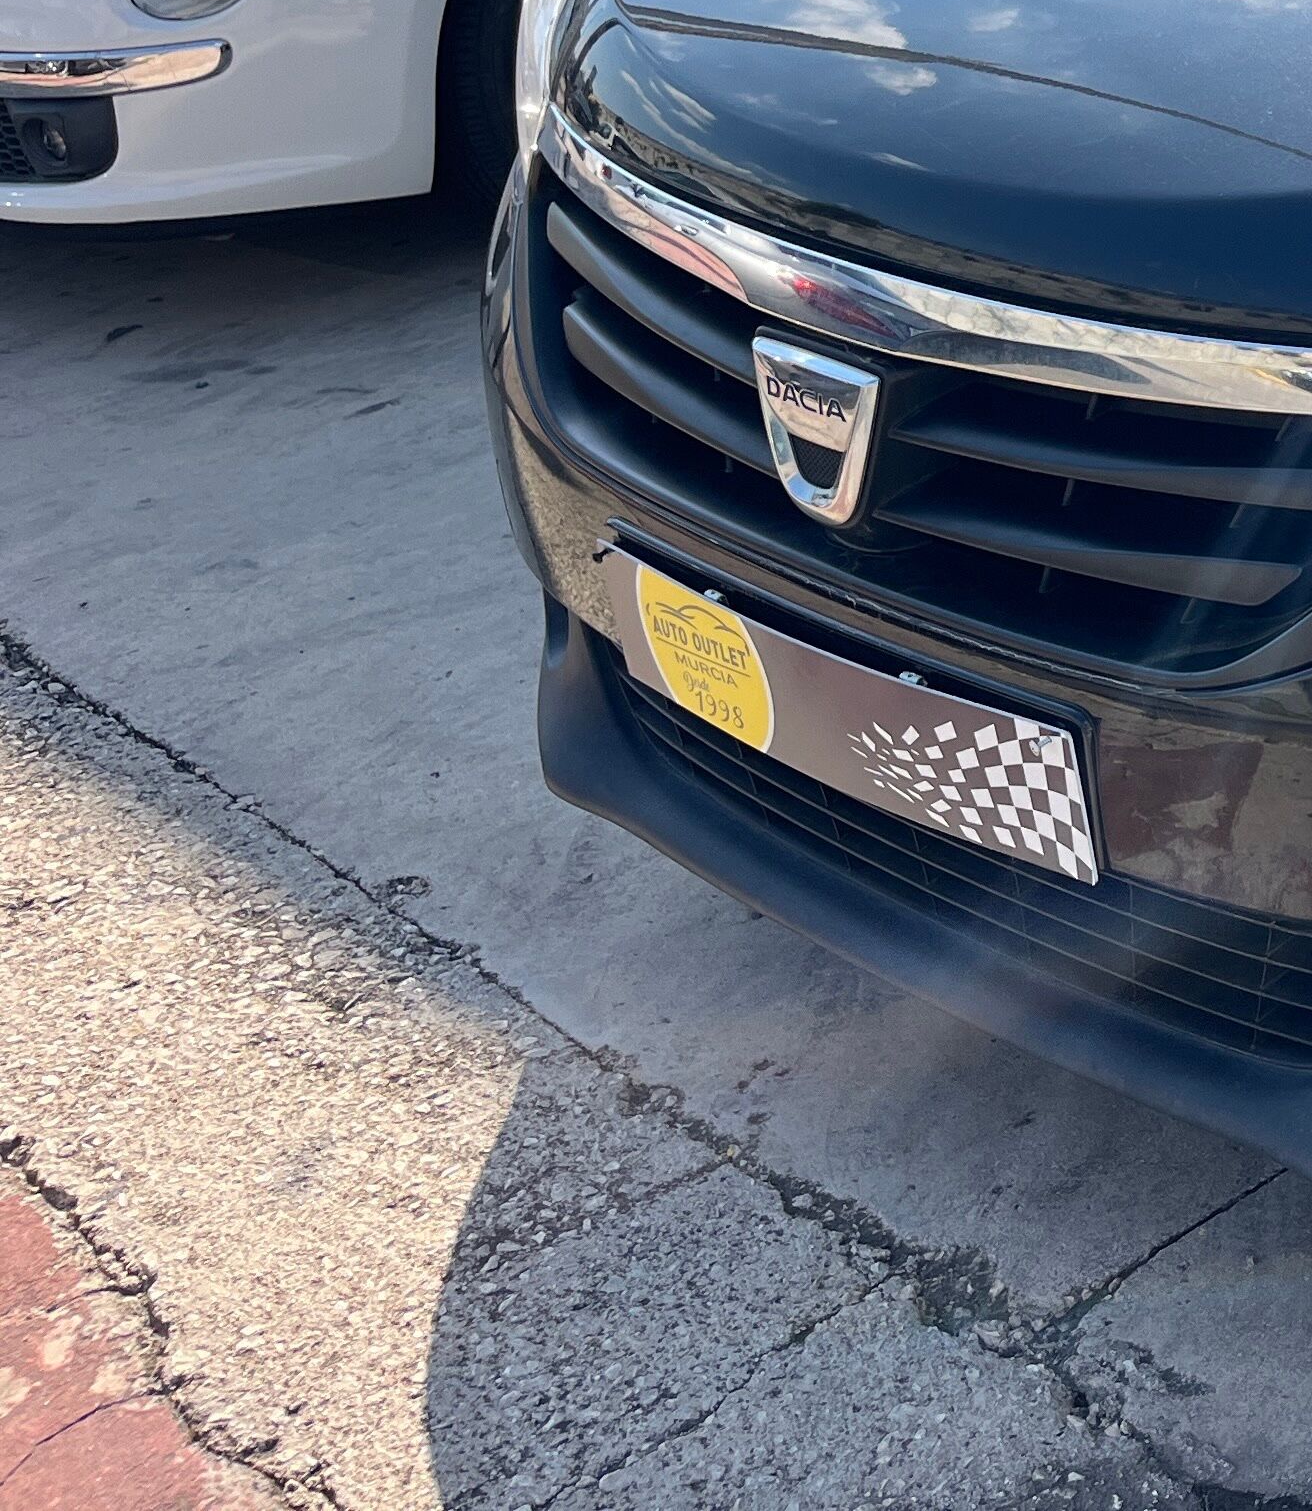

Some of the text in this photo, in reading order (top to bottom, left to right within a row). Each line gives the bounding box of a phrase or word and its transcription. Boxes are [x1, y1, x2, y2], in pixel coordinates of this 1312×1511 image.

[766, 375, 847, 423] DACIA
[653, 615, 747, 670] AUTO OUTLET
[674, 650, 739, 688] MURCIA
[695, 691, 744, 729] 1998
